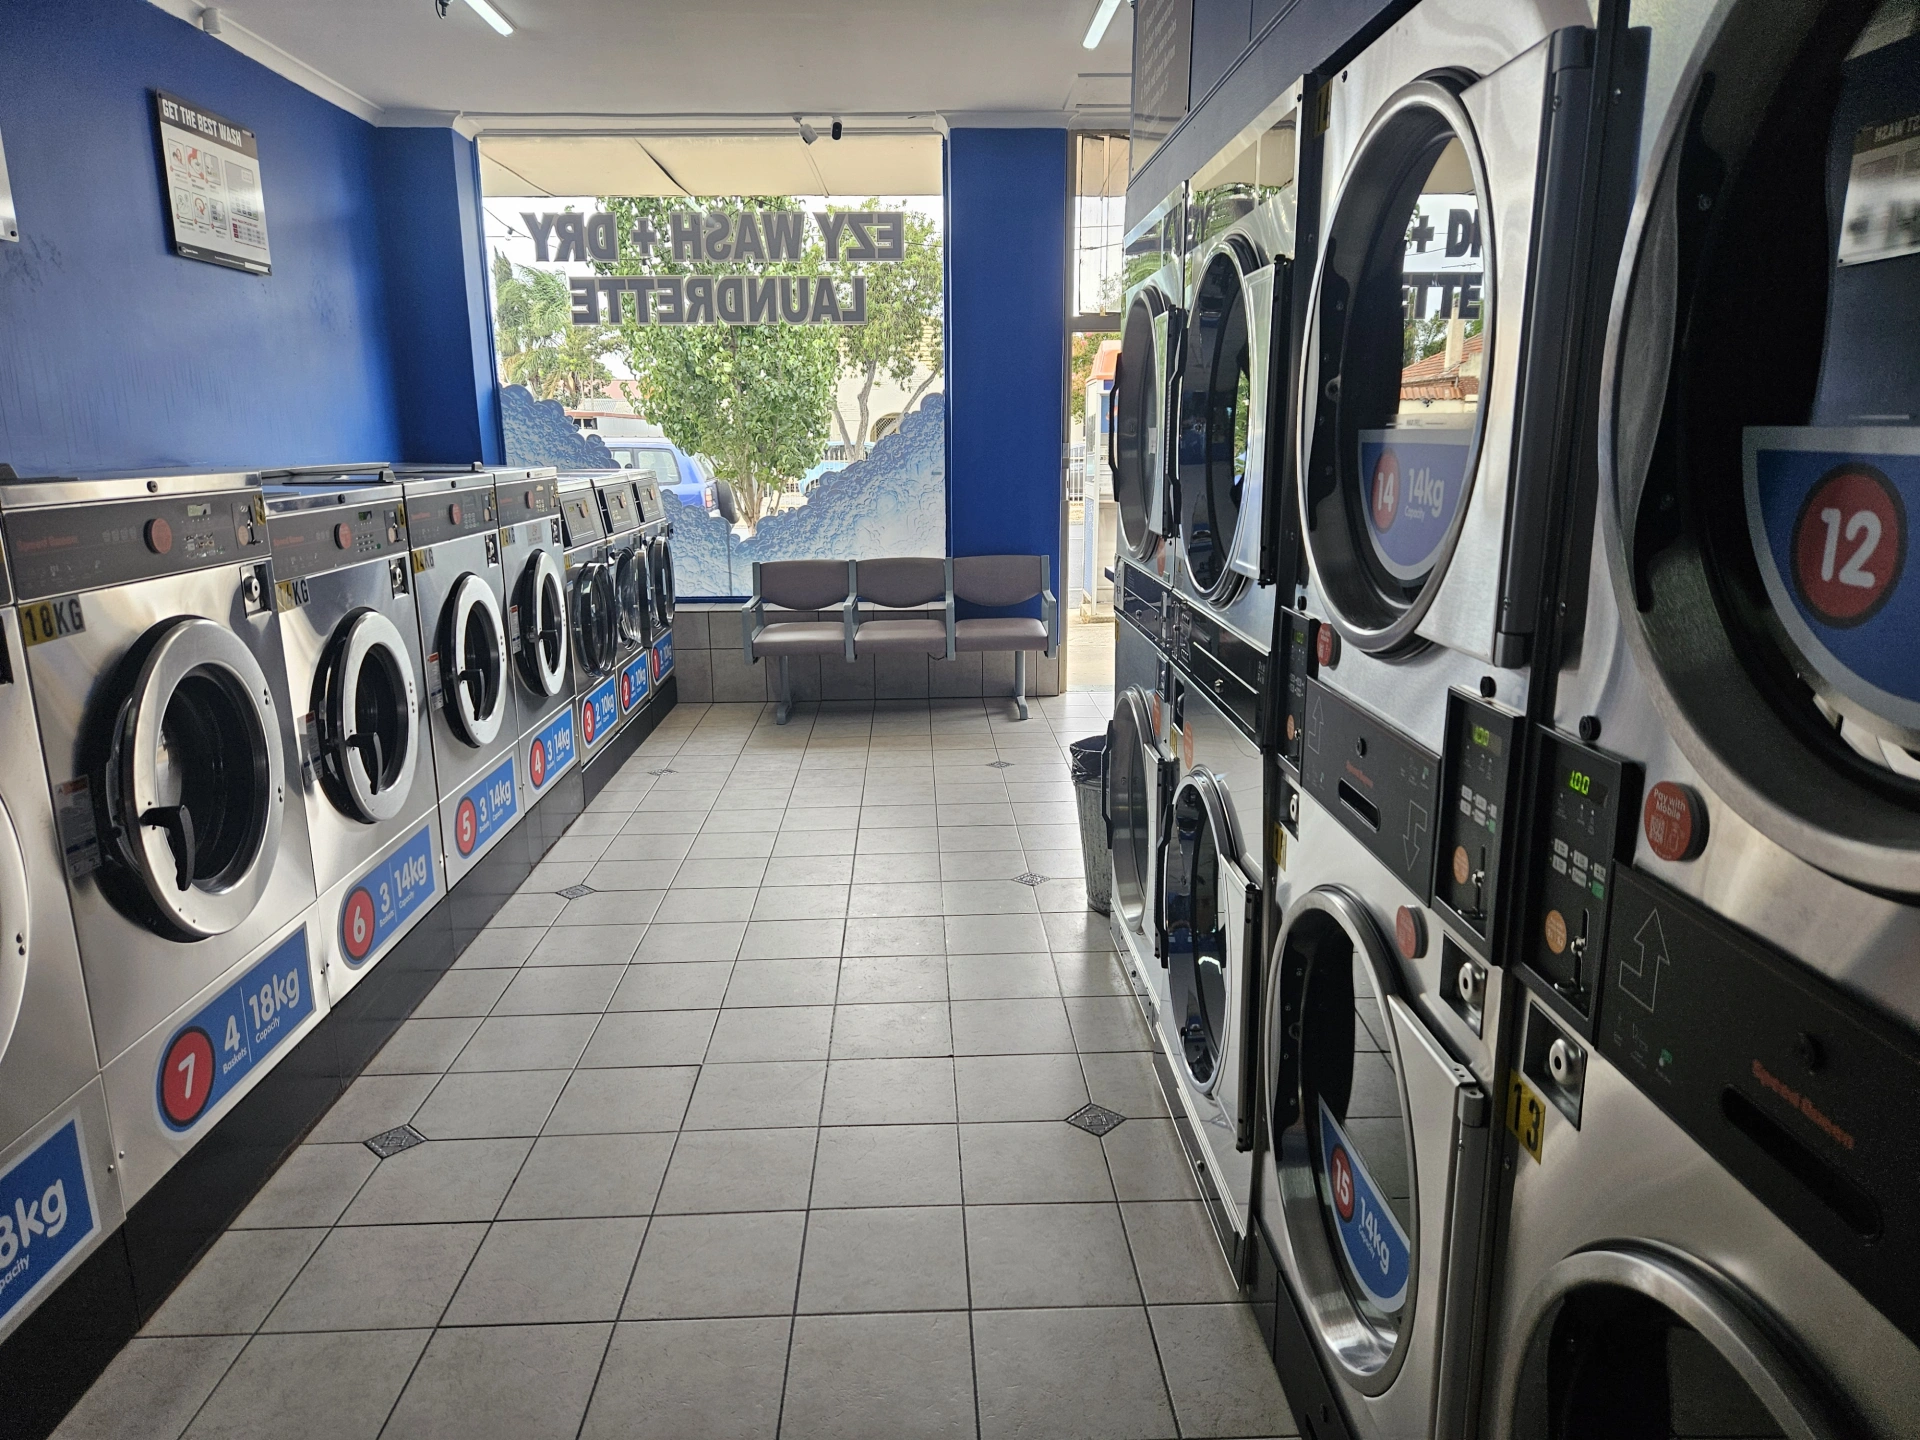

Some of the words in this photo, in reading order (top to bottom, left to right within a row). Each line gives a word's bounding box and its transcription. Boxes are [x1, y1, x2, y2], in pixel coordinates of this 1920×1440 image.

[162, 98, 179, 121] GET
[180, 106, 197, 129] THE
[197, 114, 217, 137] BEST
[218, 122, 243, 147] WASH
[1377, 471, 1395, 513] 14
[1408, 467, 1445, 518] 14kg
[1820, 507, 1882, 589] 12
[24, 598, 84, 642] 18KG
[586, 710, 592, 733] 3
[595, 702, 600, 722] 2
[601, 692, 614, 716] 10kg
[534, 749, 542, 774] 4
[547, 740, 553, 761] 3
[554, 727, 570, 754] 14kg
[462, 810, 471, 842] 5
[480, 796, 487, 822] 3
[489, 779, 511, 812] 14kg
[1653, 787, 1669, 804] Pay
[1668, 796, 1686, 812] with
[1655, 800, 1681, 820] Mobile
[353, 905, 366, 943] 6
[380, 882, 391, 912] 3
[394, 853, 427, 898] 14kg
[398, 890, 415, 909] Capacity
[178, 1052, 196, 1099] 7
[224, 1014, 240, 1052] 4
[249, 967, 300, 1030] 18kg
[222, 1046, 248, 1075] Baskets
[255, 1016, 281, 1044] Capacity
[1512, 1083, 1541, 1152] 13
[1335, 1158, 1350, 1206] 15
[1360, 1196, 1390, 1276] 14kg
